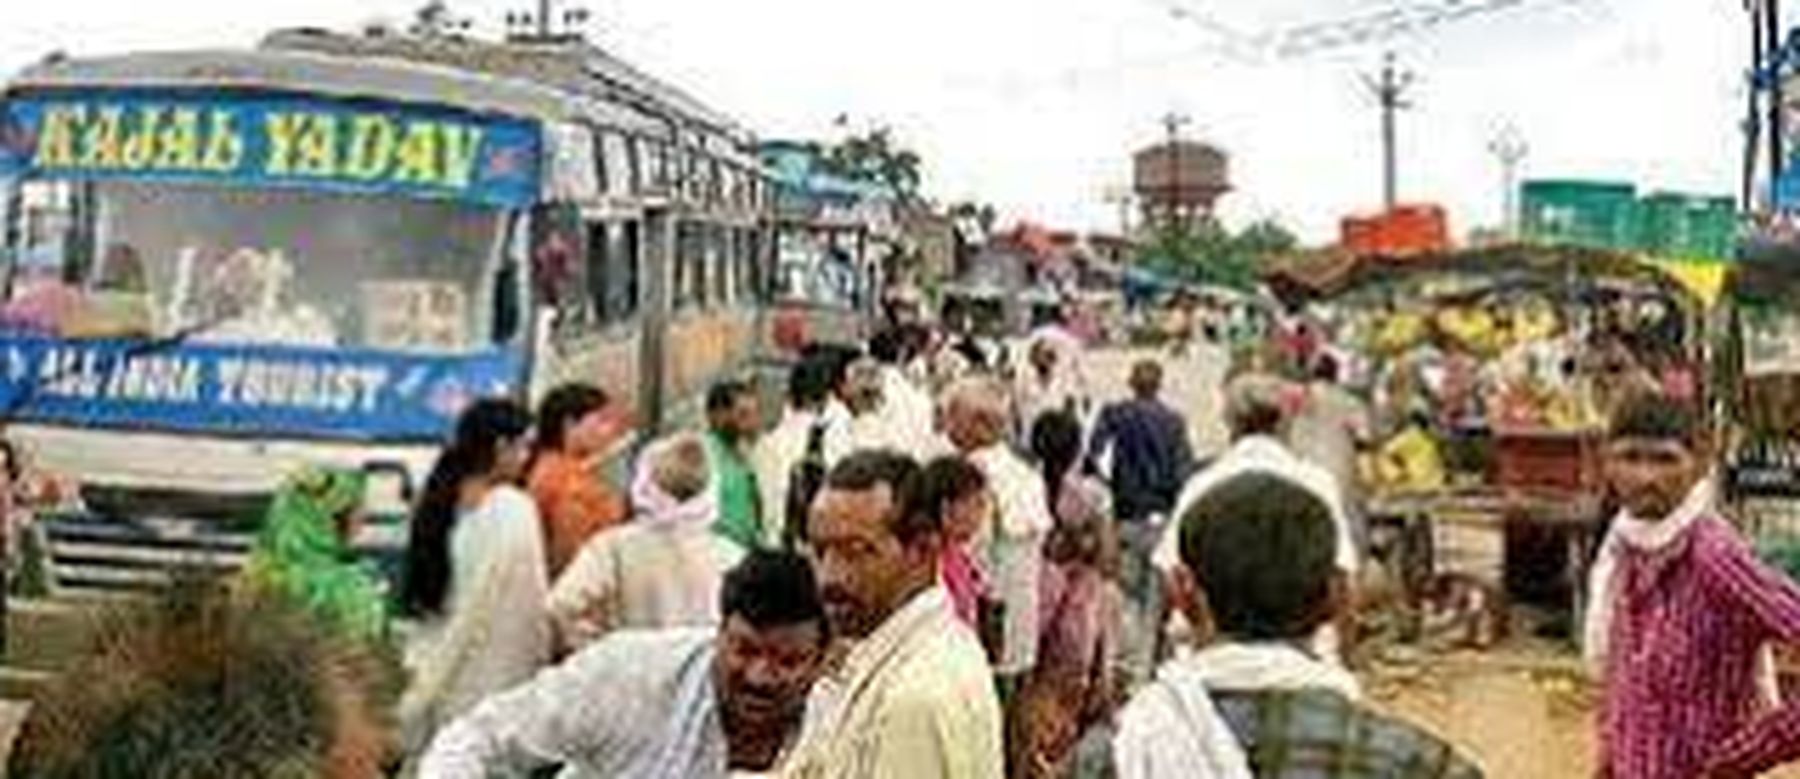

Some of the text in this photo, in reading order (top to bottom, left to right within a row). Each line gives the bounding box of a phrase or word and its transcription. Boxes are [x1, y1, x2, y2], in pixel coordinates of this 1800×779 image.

[34, 103, 484, 188] KAJAL YADAV
[38, 347, 390, 415] ALL INDIA TOURIST
